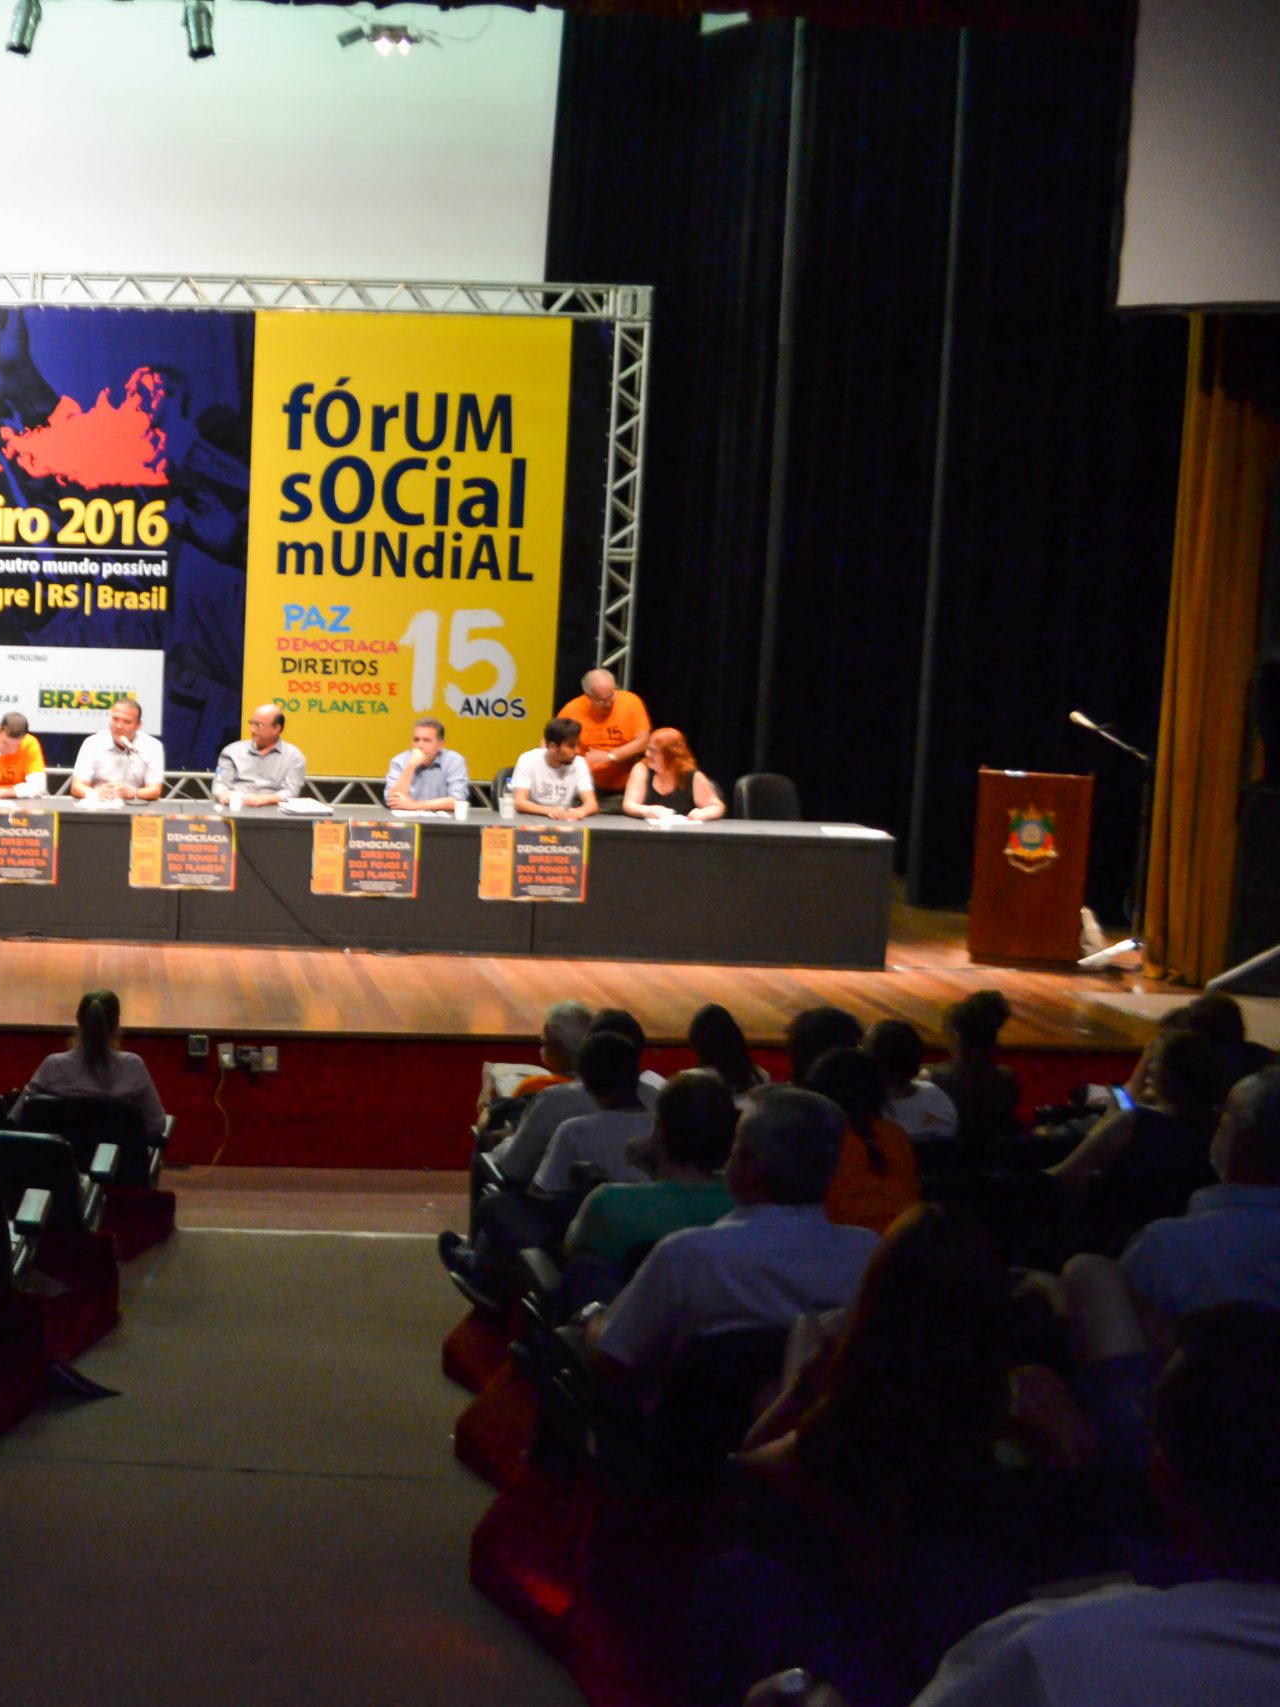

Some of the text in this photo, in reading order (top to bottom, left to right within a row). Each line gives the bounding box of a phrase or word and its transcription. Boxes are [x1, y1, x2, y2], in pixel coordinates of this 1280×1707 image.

[282, 376, 513, 454] fÓrUM
[279, 455, 527, 529] sOCial
[56, 497, 169, 546] 2016
[277, 530, 534, 582] mUNdiAL
[42, 556, 100, 575] mundo
[101, 558, 168, 579] possível
[47, 583, 79, 608] RS
[97, 584, 167, 611] Brasil
[282, 604, 352, 633] PAZ
[276, 637, 399, 655] DEMOCRACIA
[281, 657, 379, 677] DIREITOS
[399, 608, 516, 717] 15
[288, 680, 397, 696] DOS POVOS E
[272, 697, 389, 715] DO PLANETA
[459, 697, 527, 719] ANOS
[166, 833, 228, 842] DEMOCRACIA
[349, 840, 411, 849] DEMOCRACIA
[516, 844, 579, 854] DEMOCRACIA
